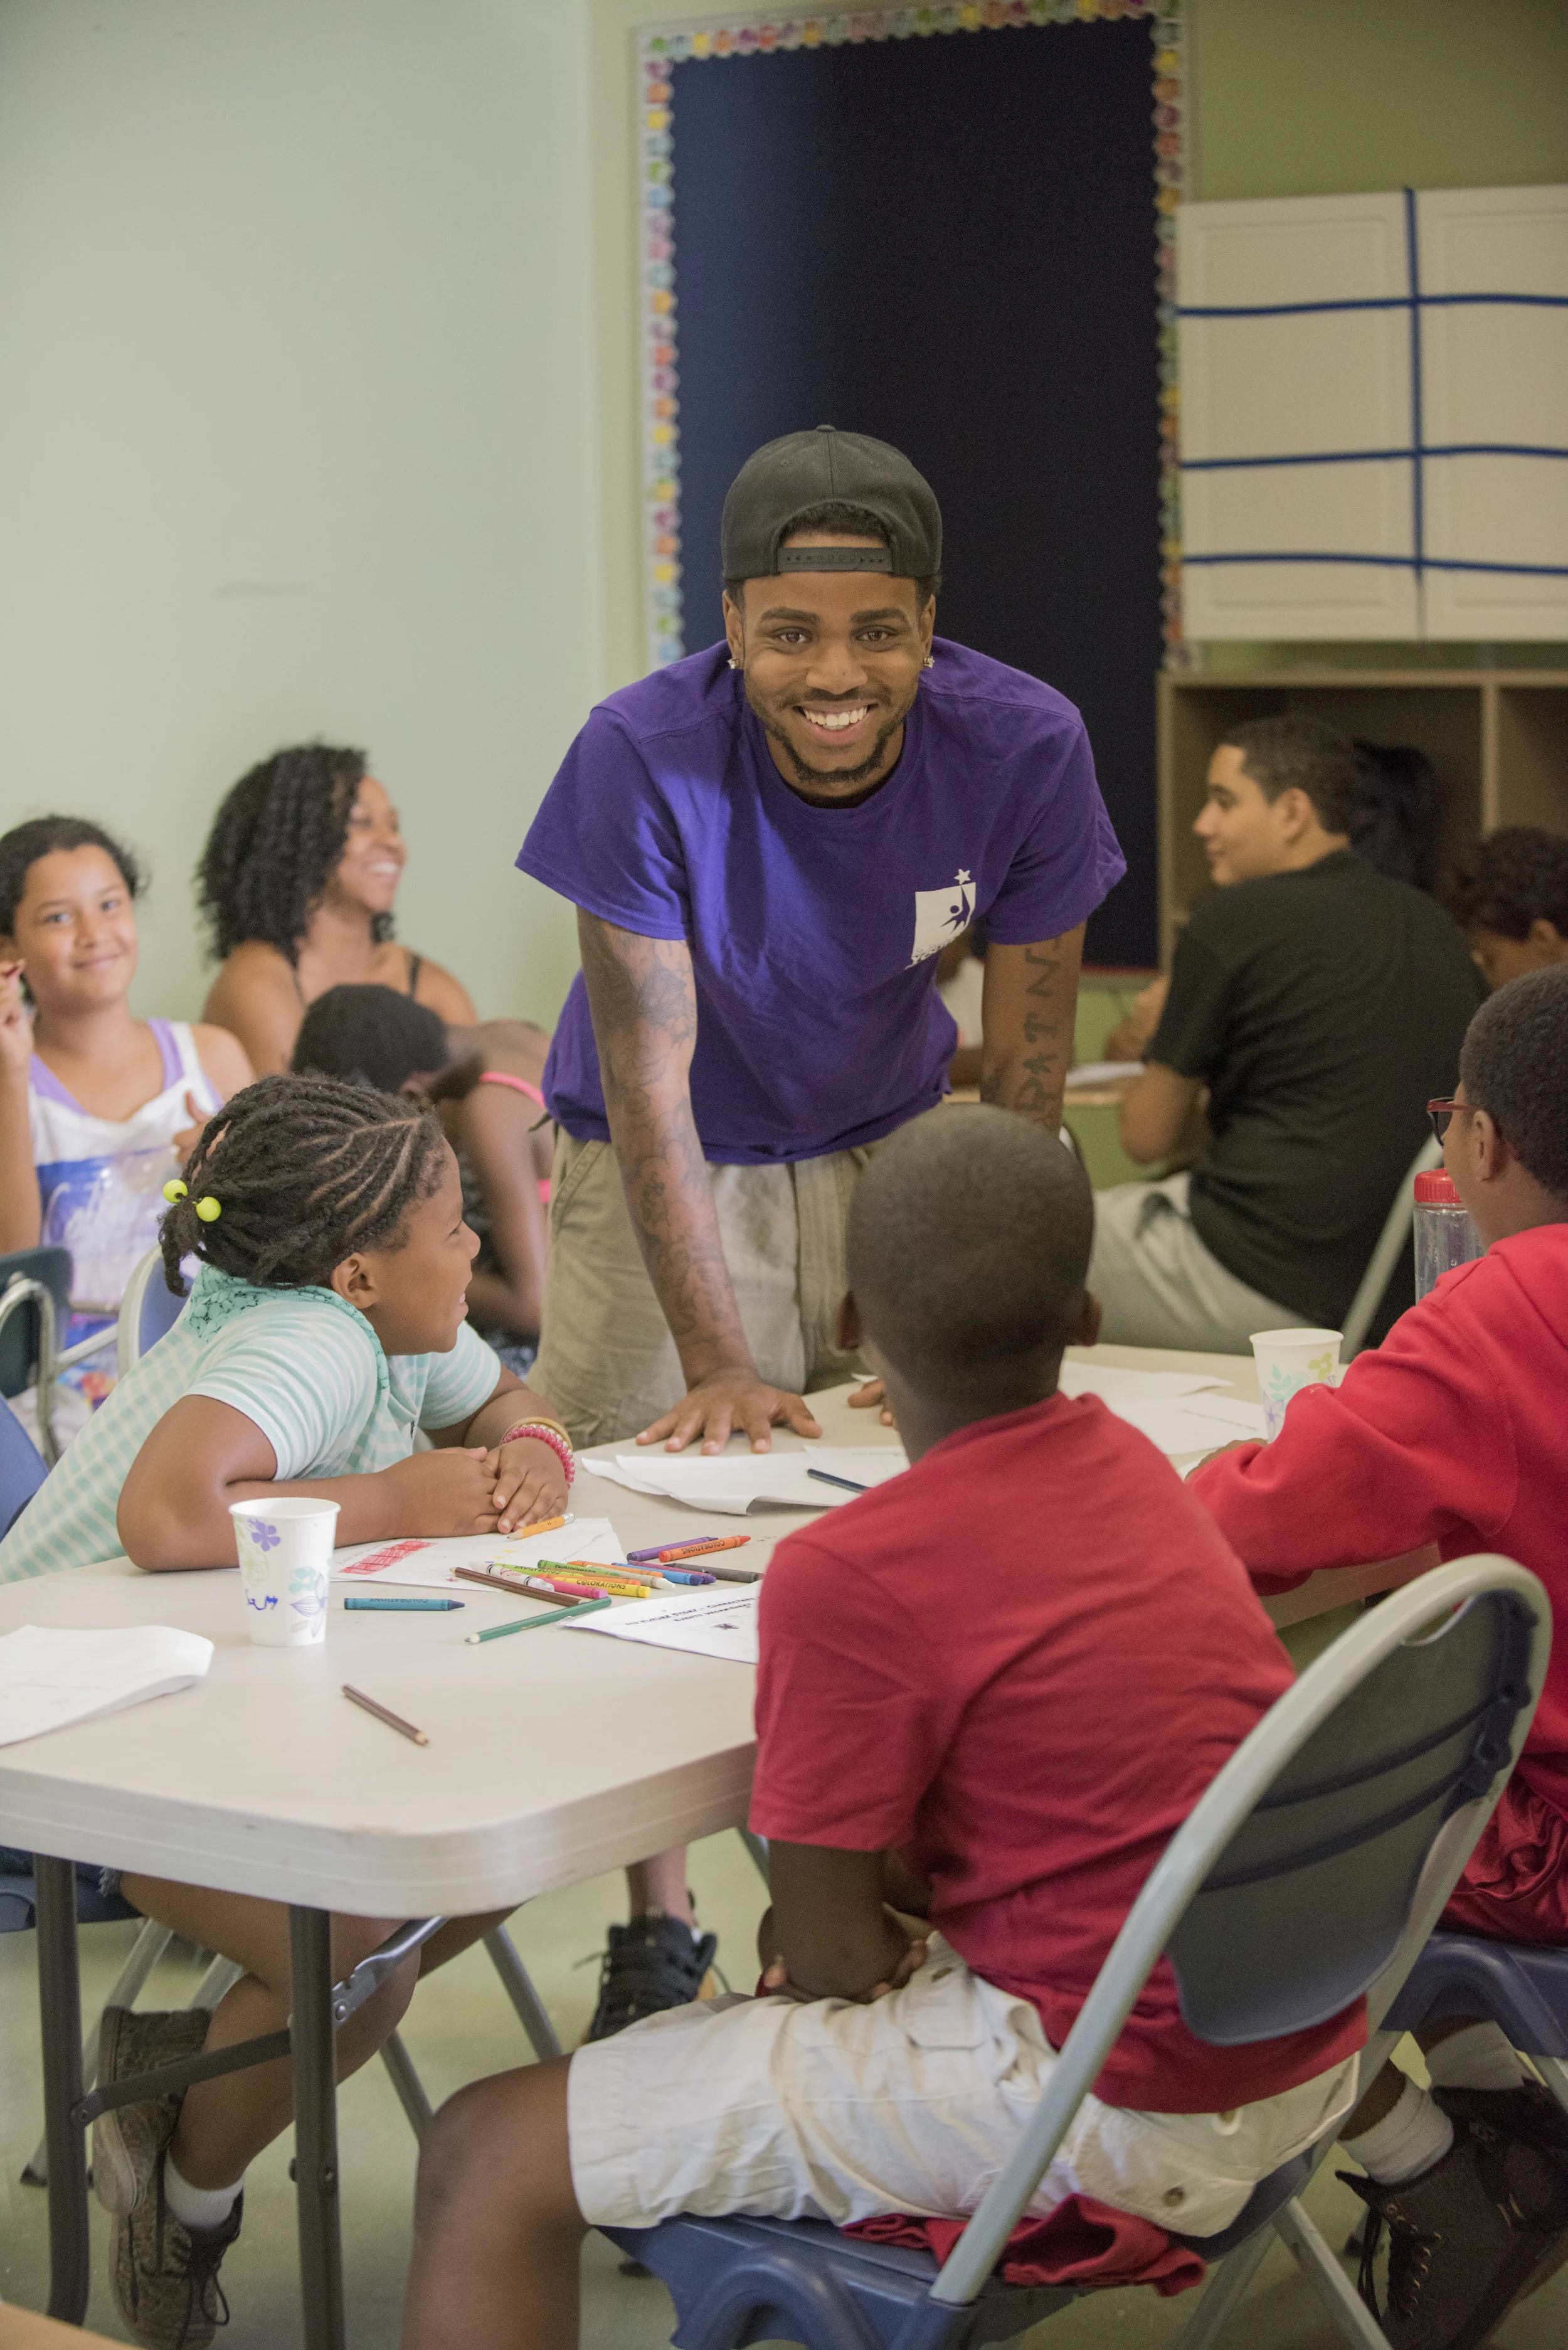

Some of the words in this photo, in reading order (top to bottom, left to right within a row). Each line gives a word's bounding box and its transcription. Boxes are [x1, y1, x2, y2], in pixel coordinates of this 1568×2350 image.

[681, 1540, 725, 1555] COLORATIONS
[576, 1579, 627, 1590] COLORATIONS
[704, 1603, 751, 1615] WORKSHEET
[639, 1615, 672, 1623] FUTURE
